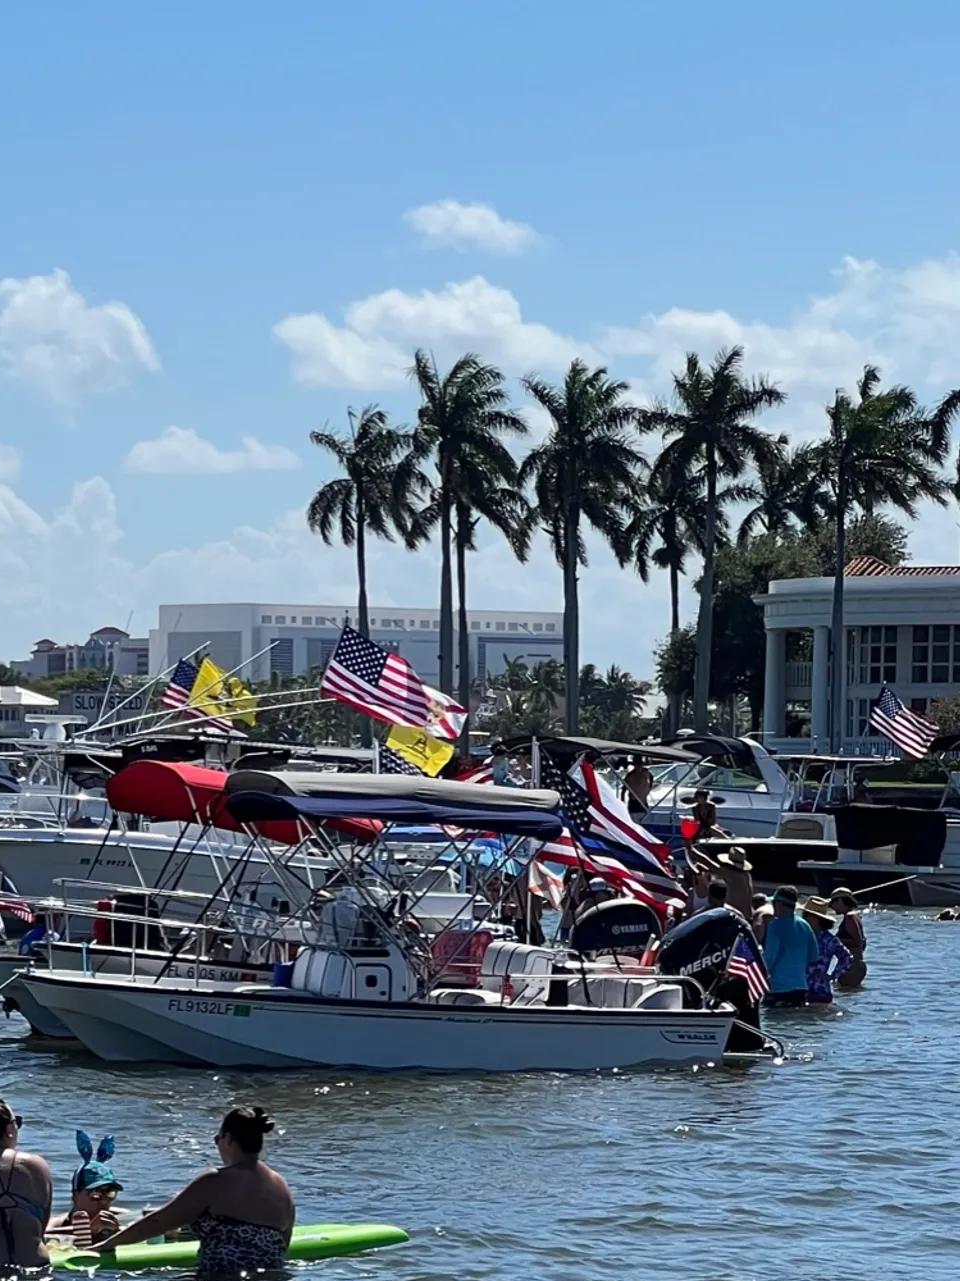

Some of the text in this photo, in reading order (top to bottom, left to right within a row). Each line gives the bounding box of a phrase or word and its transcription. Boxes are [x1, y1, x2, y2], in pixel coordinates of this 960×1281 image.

[74, 695, 106, 710] SLOW
[619, 923, 648, 933] YAMAHA
[167, 965, 239, 981] FL 605 KM
[168, 999, 233, 1015] FL9132LF
